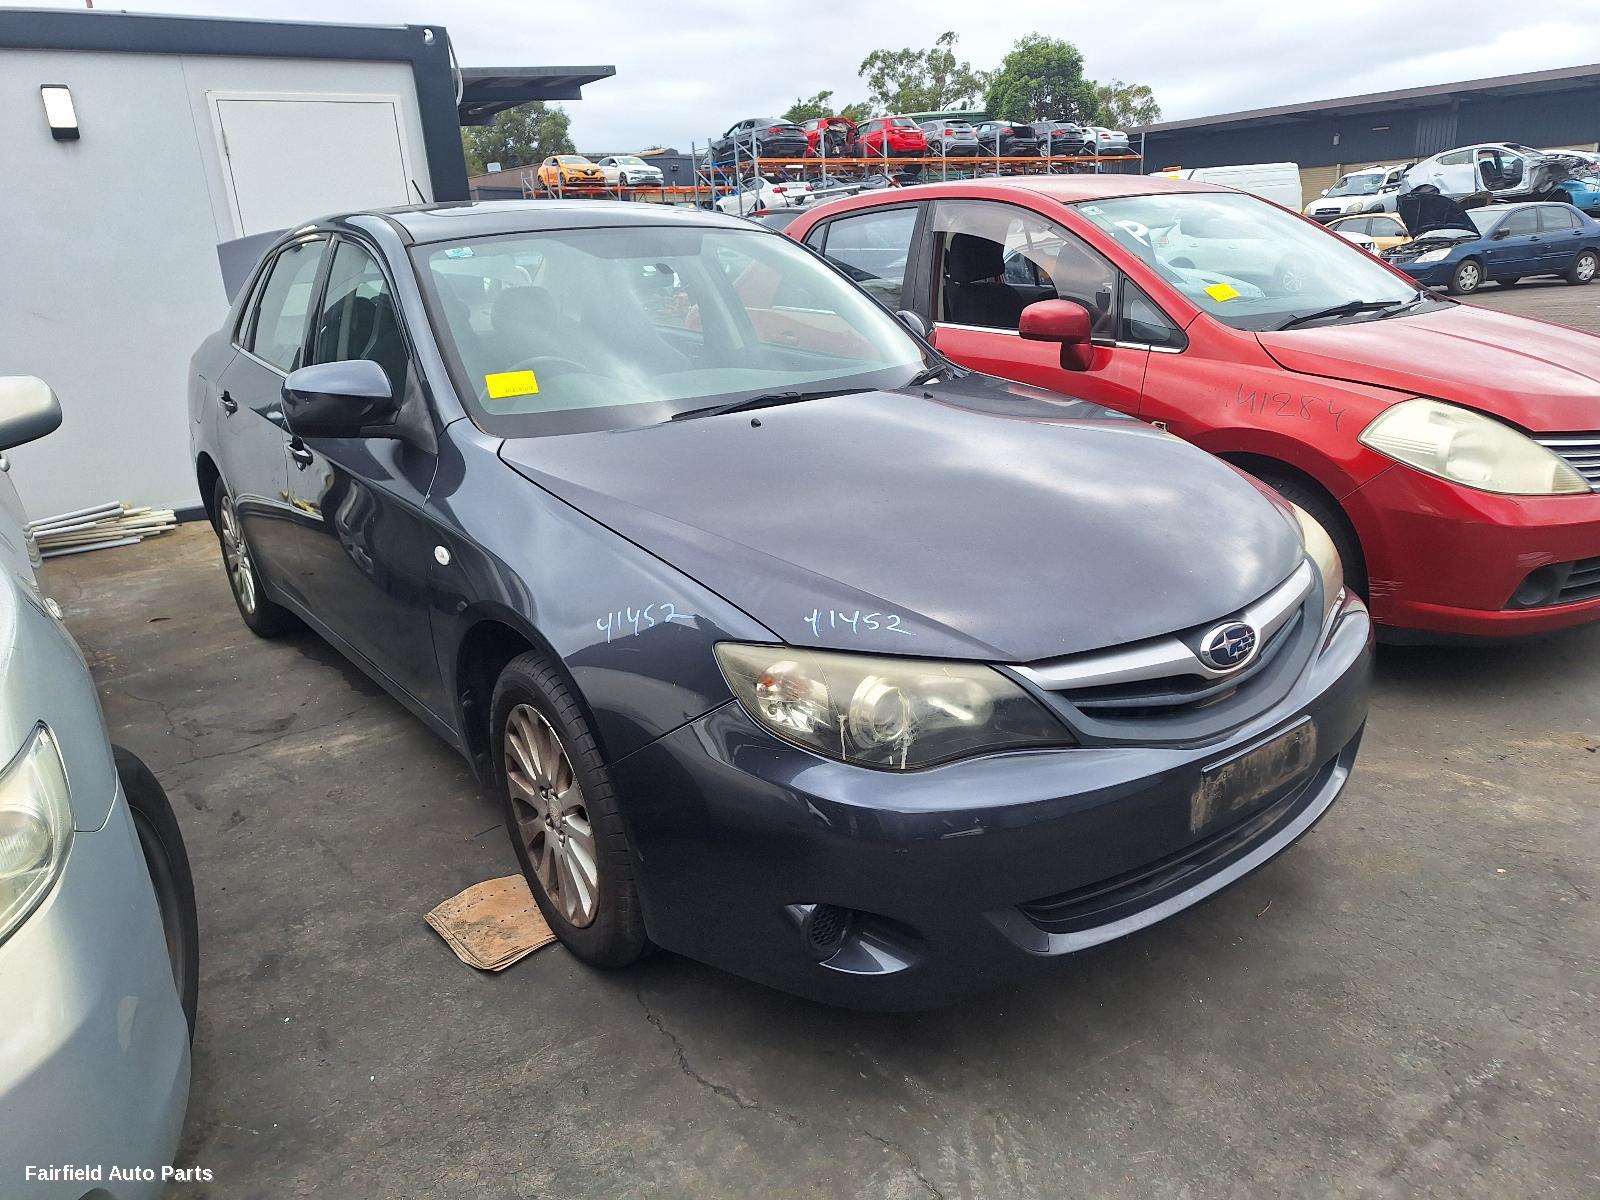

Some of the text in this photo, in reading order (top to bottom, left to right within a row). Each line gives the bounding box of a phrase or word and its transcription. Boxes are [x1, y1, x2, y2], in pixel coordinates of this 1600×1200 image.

[1237, 383, 1346, 432] 41284
[596, 603, 697, 643] 41452
[803, 608, 917, 637] 41452
